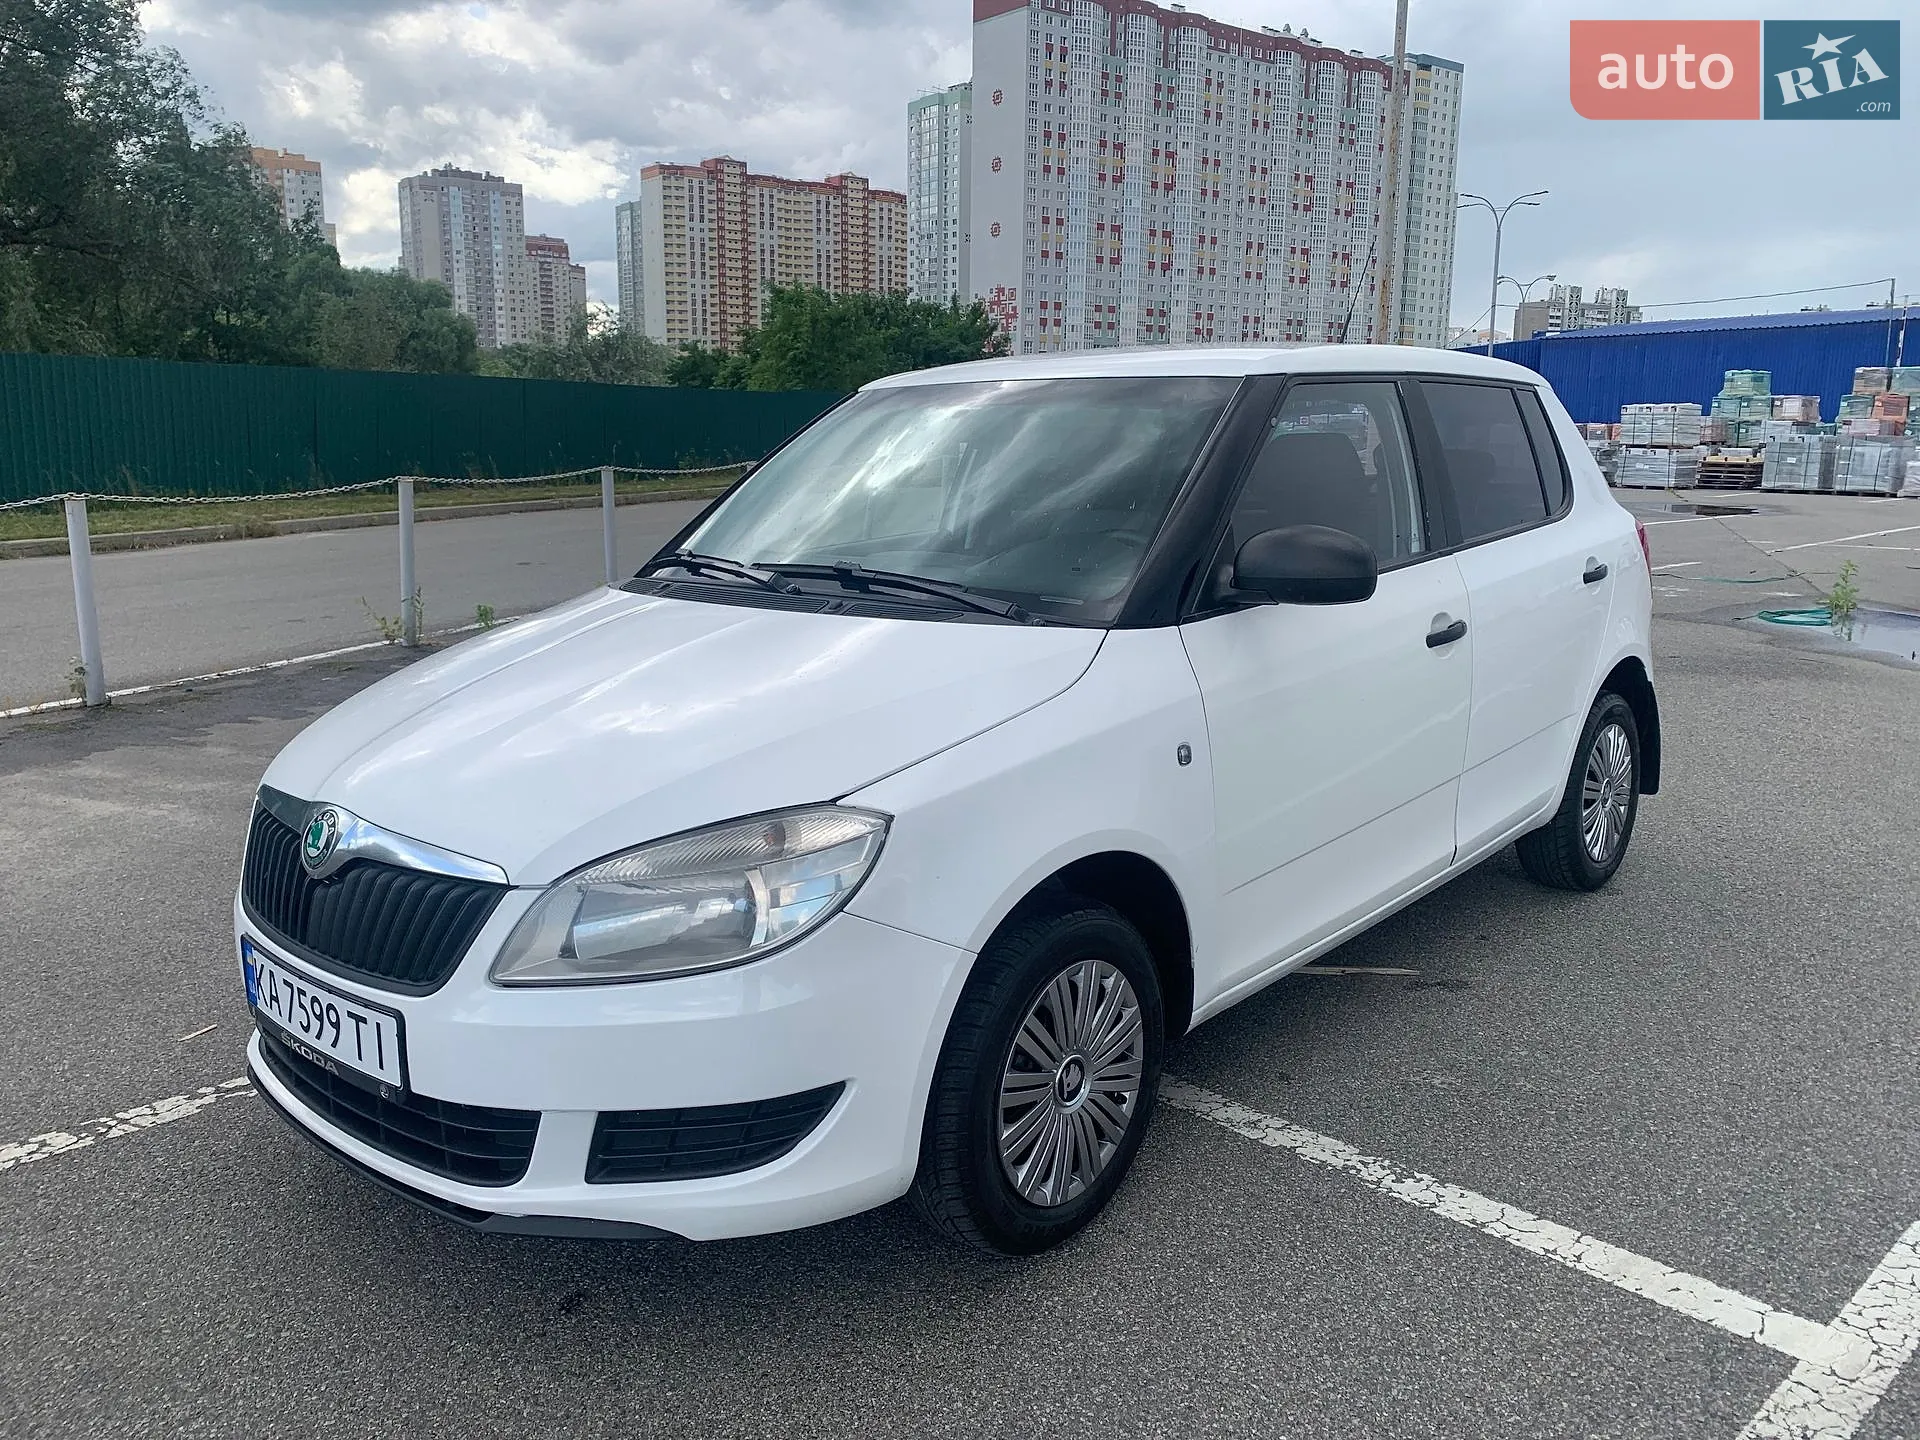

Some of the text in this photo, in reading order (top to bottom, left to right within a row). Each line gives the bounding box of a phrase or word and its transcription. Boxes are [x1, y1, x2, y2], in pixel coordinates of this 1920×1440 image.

[254, 958, 384, 1070] KA 7599 TI
